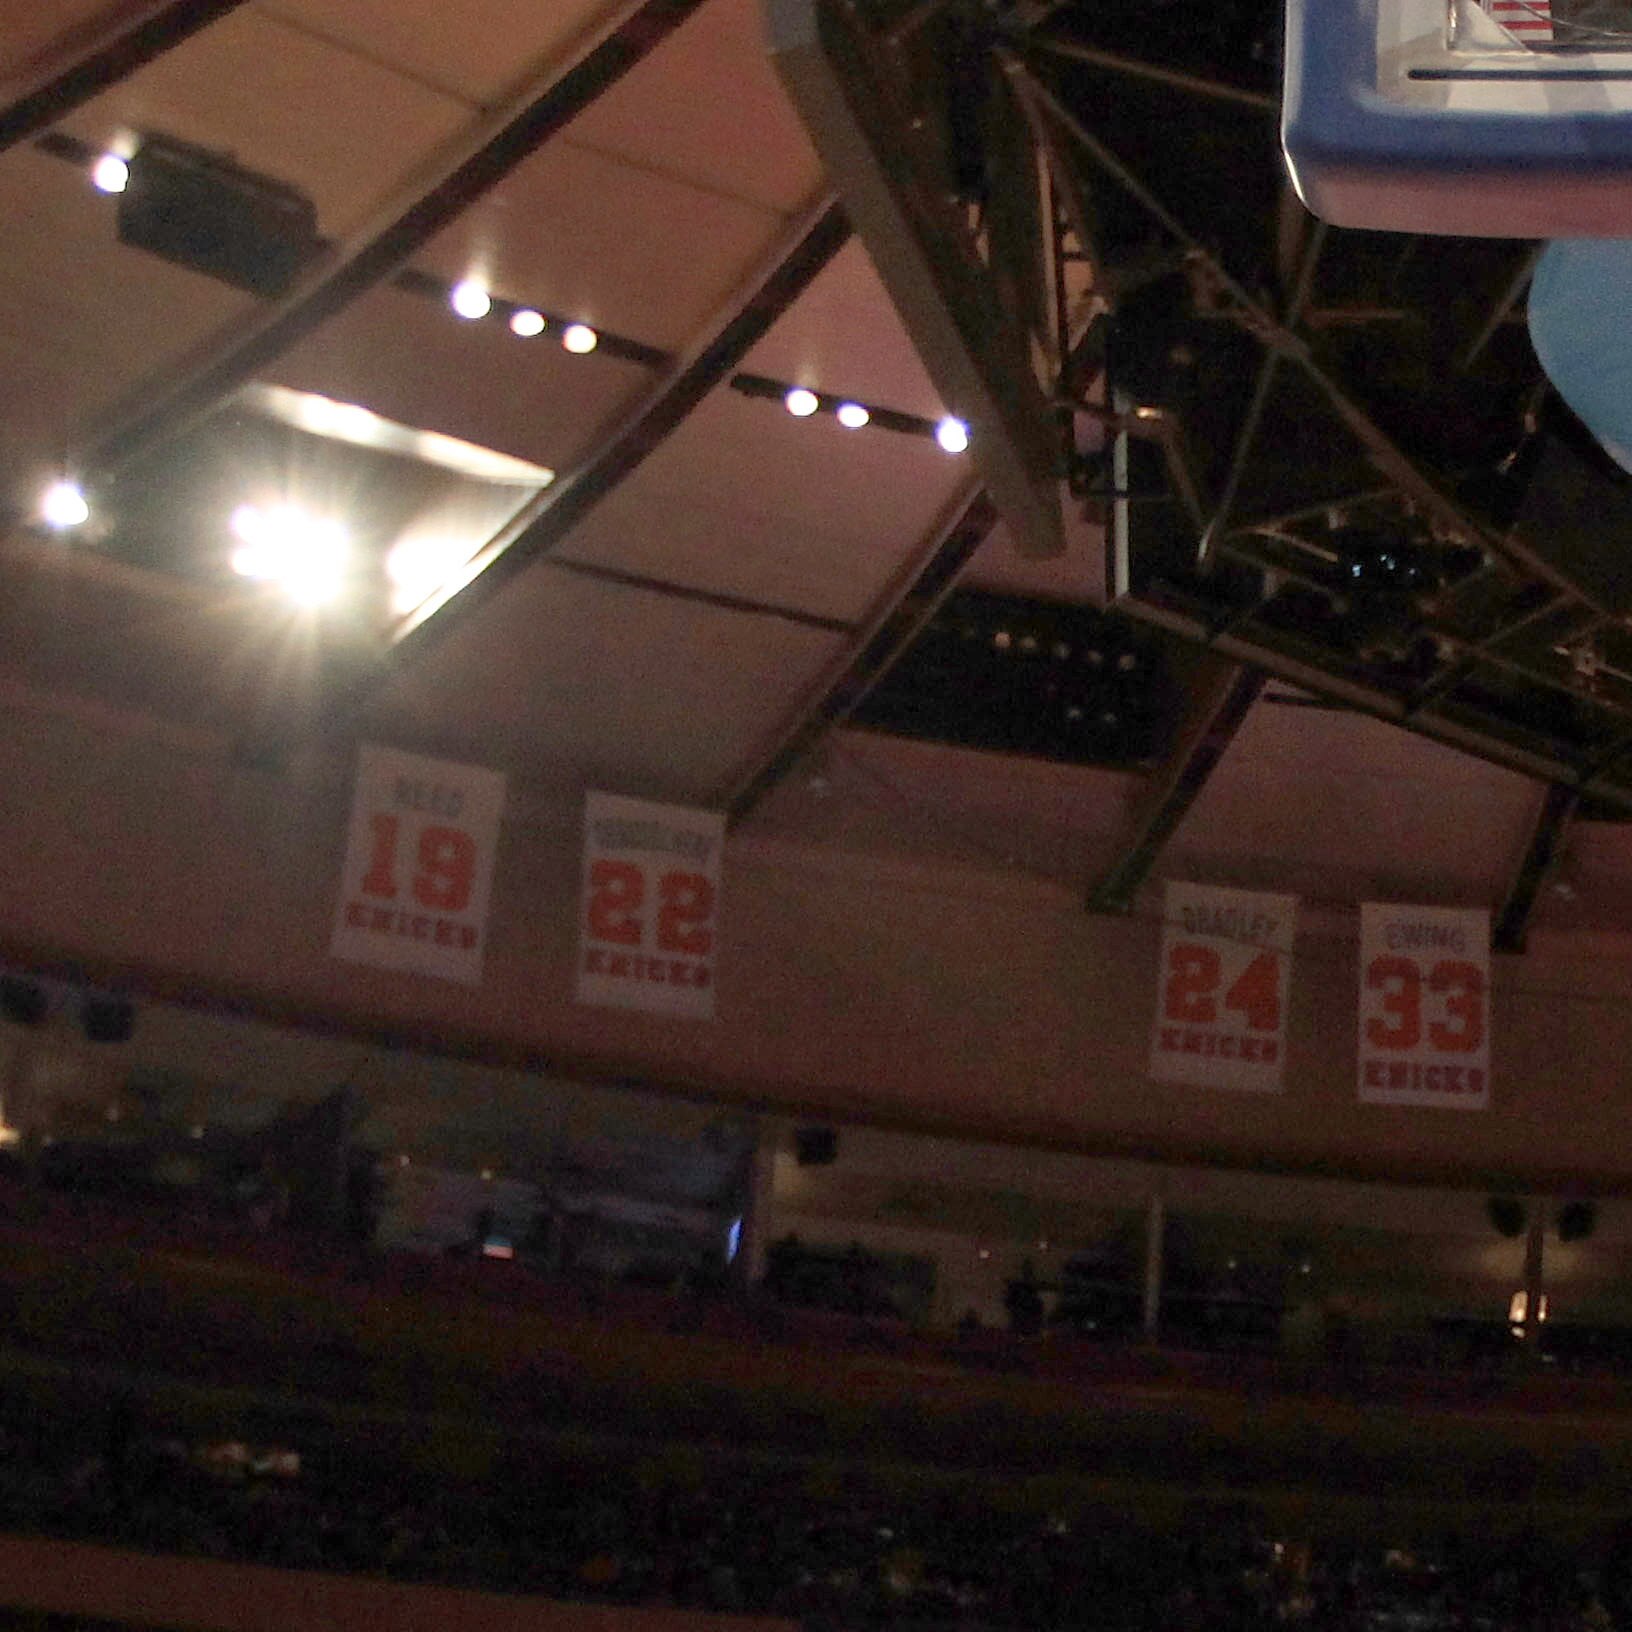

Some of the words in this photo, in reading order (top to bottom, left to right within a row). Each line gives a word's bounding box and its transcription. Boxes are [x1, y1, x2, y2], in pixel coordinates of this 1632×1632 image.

[362, 814, 476, 911] 19
[588, 859, 714, 956] 22
[1165, 944, 1281, 1031] 24
[1367, 956, 1483, 1052] 33
[1365, 1061, 1484, 1094] KNICKS
